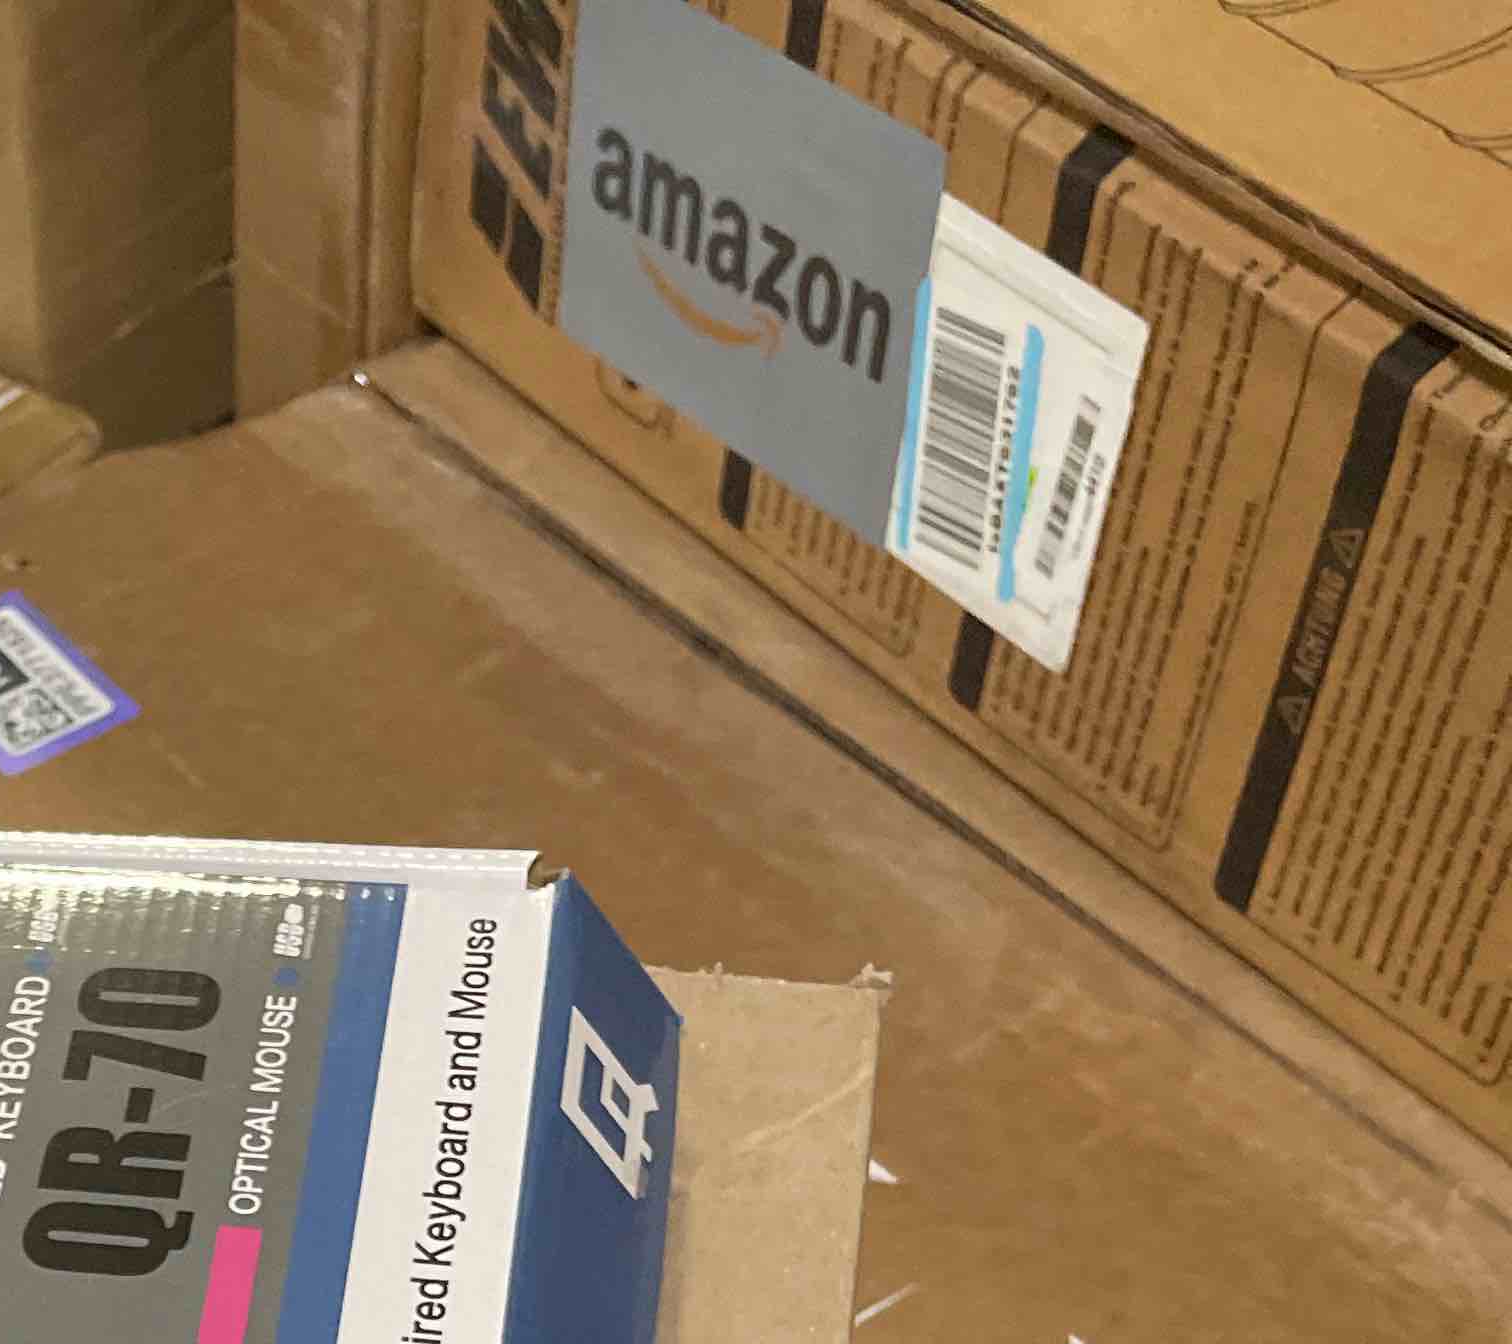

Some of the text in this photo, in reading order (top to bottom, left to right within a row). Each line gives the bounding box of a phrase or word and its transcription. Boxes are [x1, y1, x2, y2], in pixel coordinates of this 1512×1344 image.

[592, 127, 891, 383] amazon
[444, 1029, 482, 1092] and
[447, 917, 497, 1022] Mouse
[22, 966, 222, 1277] QR-70
[228, 994, 297, 1216] OPTICAL MOUSE
[412, 1099, 473, 1267] Keyboard
